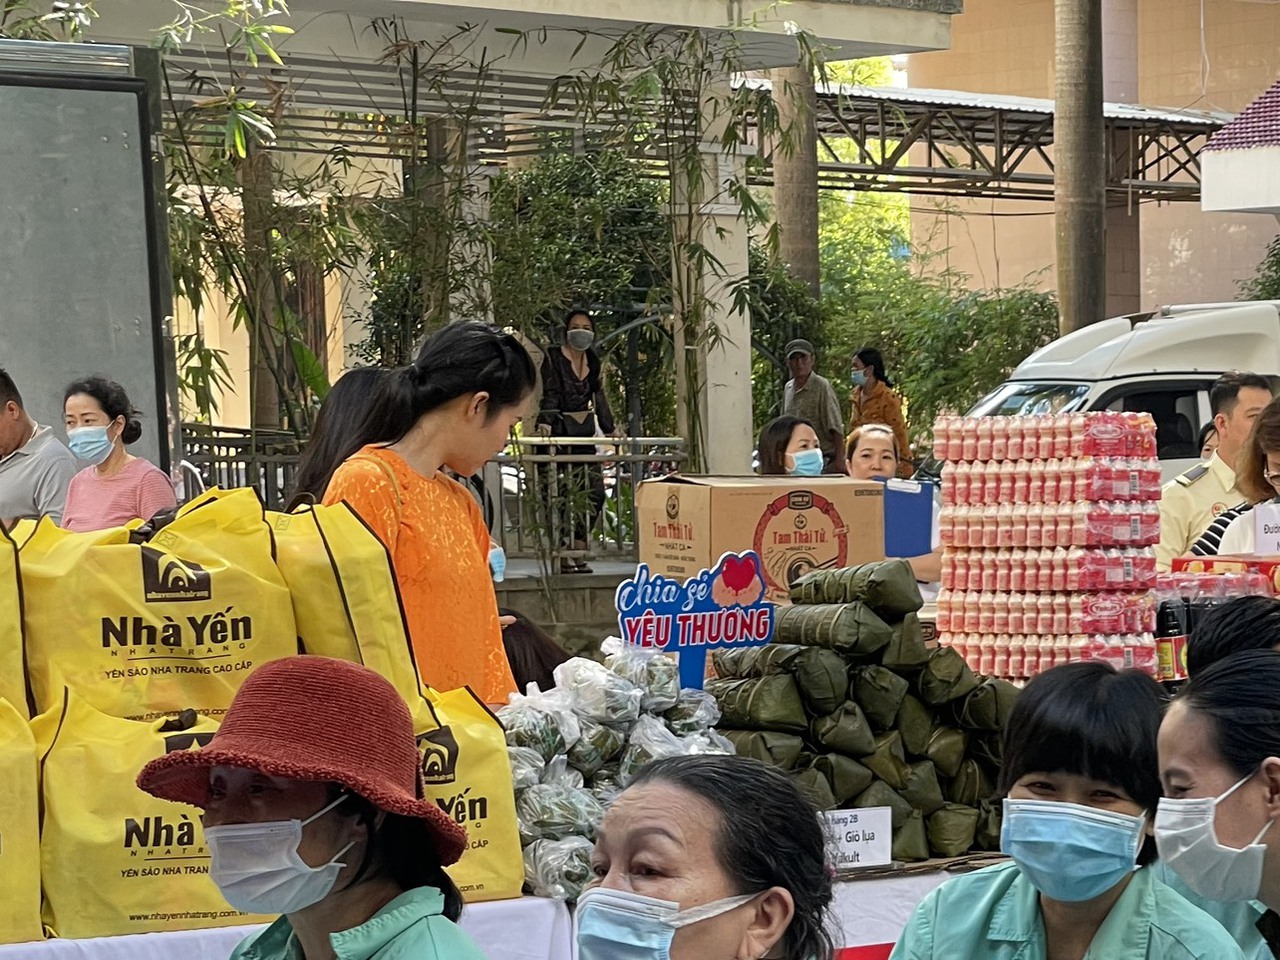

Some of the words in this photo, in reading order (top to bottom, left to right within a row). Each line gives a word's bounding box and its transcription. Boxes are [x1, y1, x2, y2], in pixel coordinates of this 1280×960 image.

[773, 531, 791, 544] Tam
[101, 615, 182, 647] Nhà
[186, 606, 252, 646] Yến
[625, 609, 671, 648] YÊU
[677, 608, 770, 647] THƯƠNG
[151, 666, 172, 676] NHA
[175, 666, 211, 675] TRANG
[212, 664, 233, 674] CAO
[849, 814, 858, 823] 2B
[124, 814, 194, 848] Nhà
[845, 830, 860, 843] Giò
[862, 830, 875, 844] lụa
[162, 867, 181, 875] NHA
[184, 866, 209, 875] TRAN
